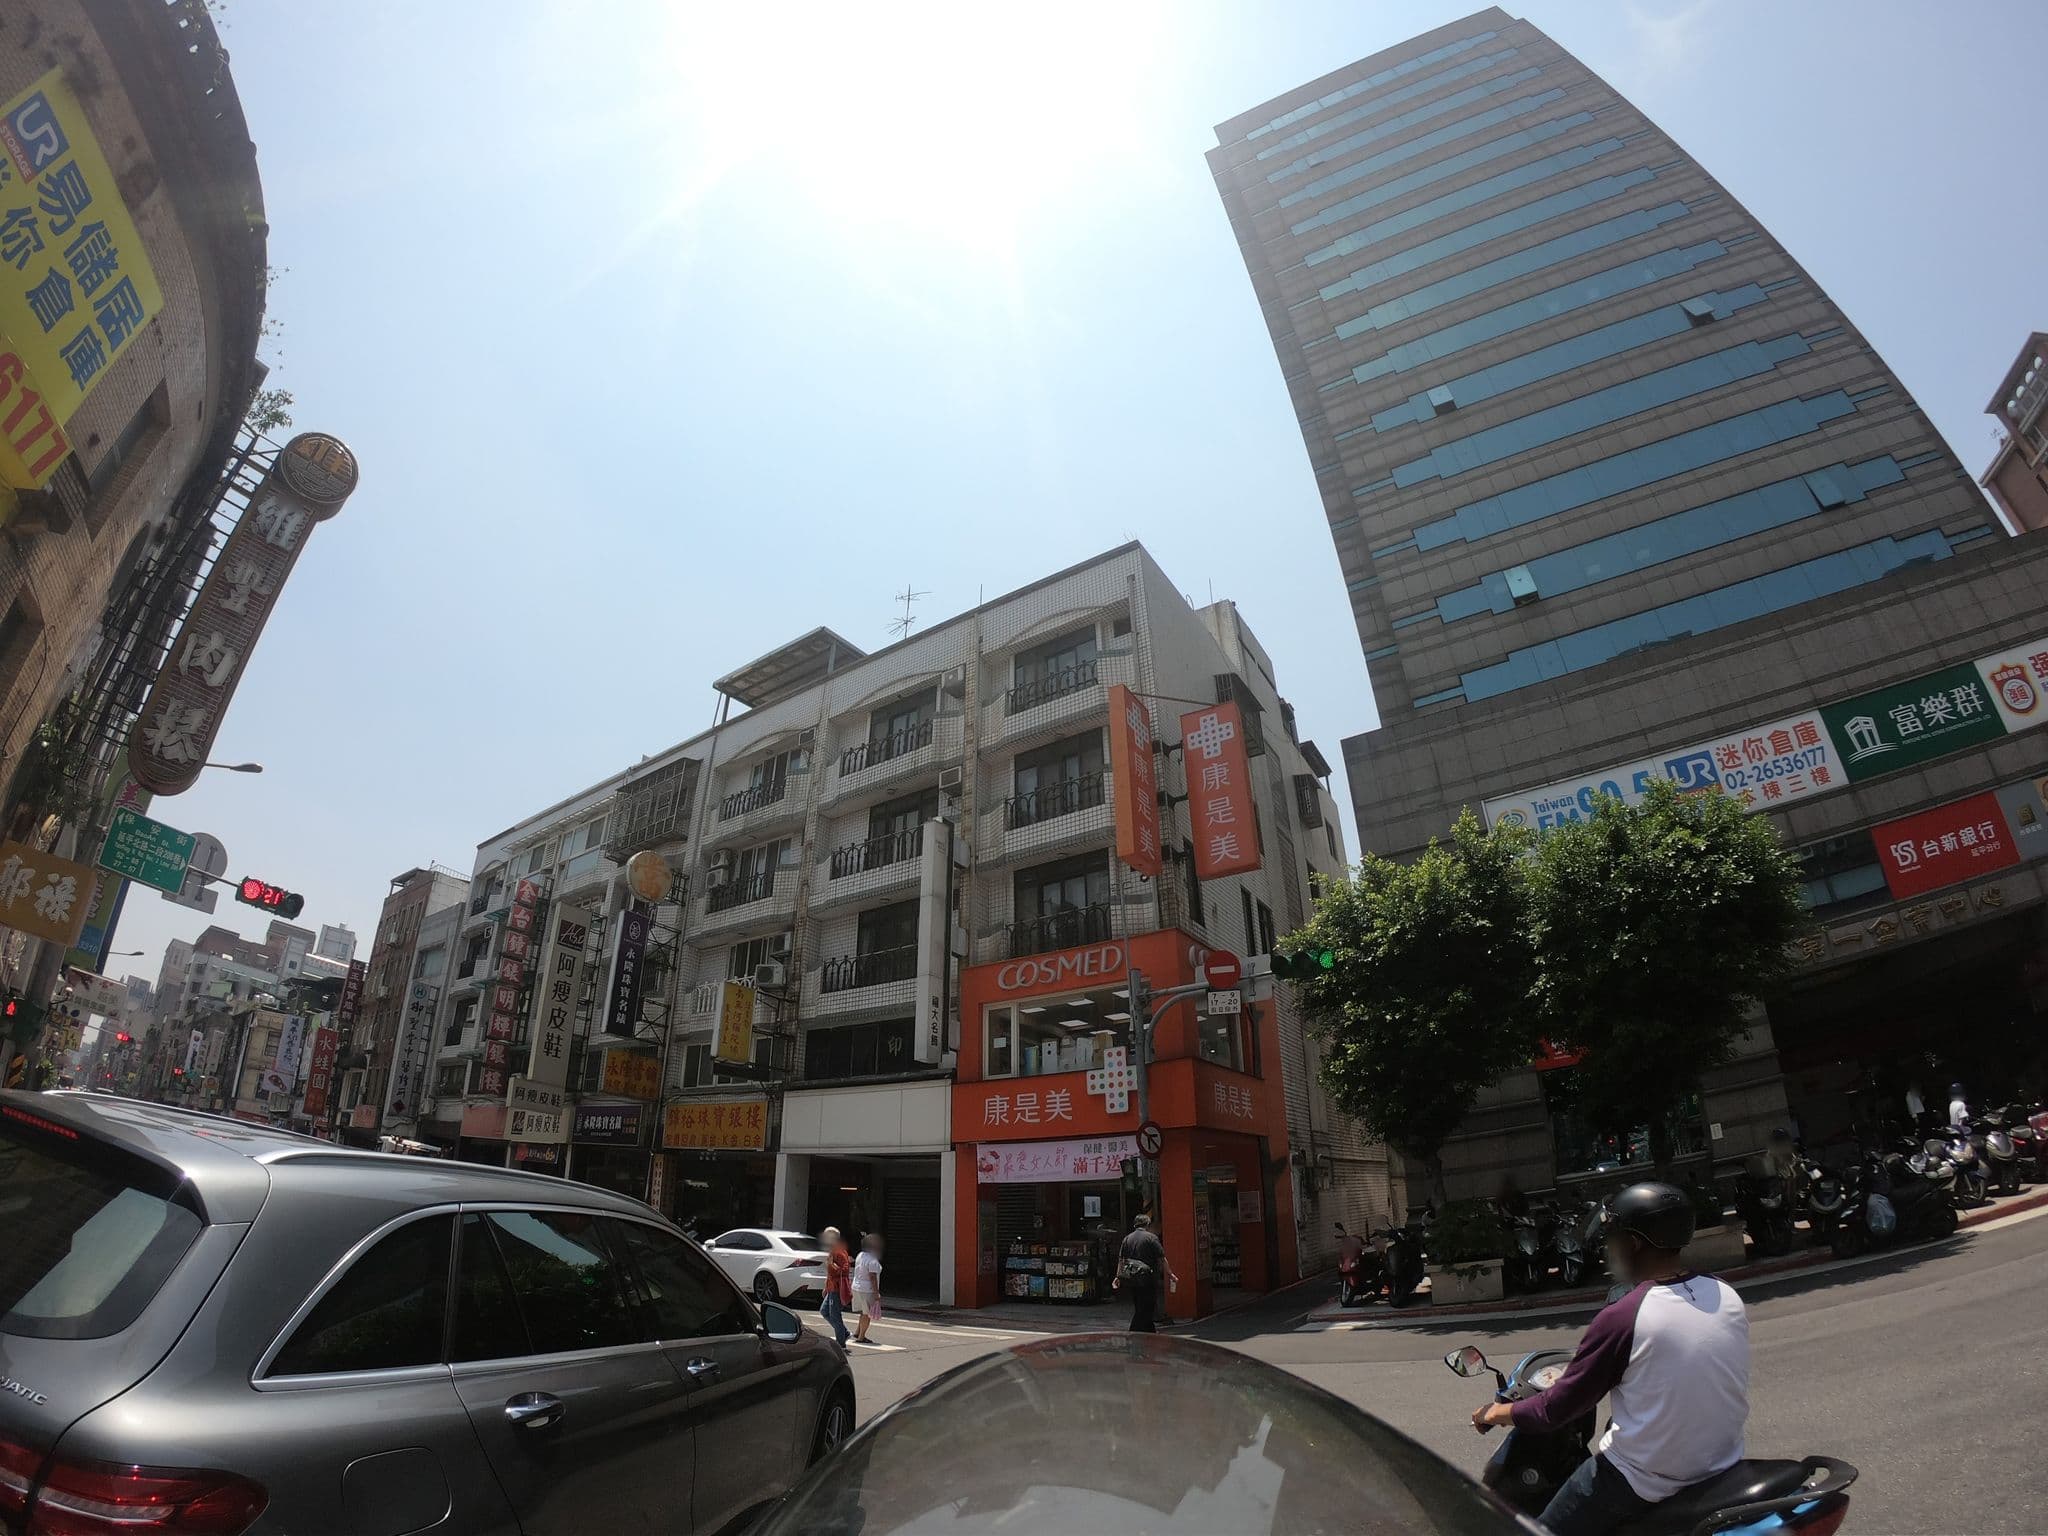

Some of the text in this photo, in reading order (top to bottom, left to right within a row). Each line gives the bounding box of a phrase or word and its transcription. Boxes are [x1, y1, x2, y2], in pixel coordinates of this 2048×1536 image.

[0, 124, 32, 179] STORAGE
[16, 101, 59, 166] UR
[0, 157, 107, 392] 你倉庫
[37, 160, 145, 353] 易儲居
[1888, 682, 1985, 737] 富樂群
[1715, 720, 1824, 771] 迷你倉庫
[1724, 745, 1828, 790] 02-26536177
[1134, 751, 1156, 861] 康是美
[1202, 762, 1240, 865] 康是美
[1531, 795, 1575, 816] Taiwan
[124, 813, 188, 847] 保安街
[1921, 820, 1996, 859] 台新銀行
[997, 945, 1123, 990] COSMED
[543, 952, 577, 1060] 阿瘦皮鞋
[514, 1086, 562, 1108] 阿瘦皮鞋
[983, 1088, 1073, 1126] 康是美
[1213, 1082, 1254, 1120] 康是美
[525, 1113, 561, 1134] 阿瘦皮鞋
[1073, 1152, 1140, 1176] 滿千送
